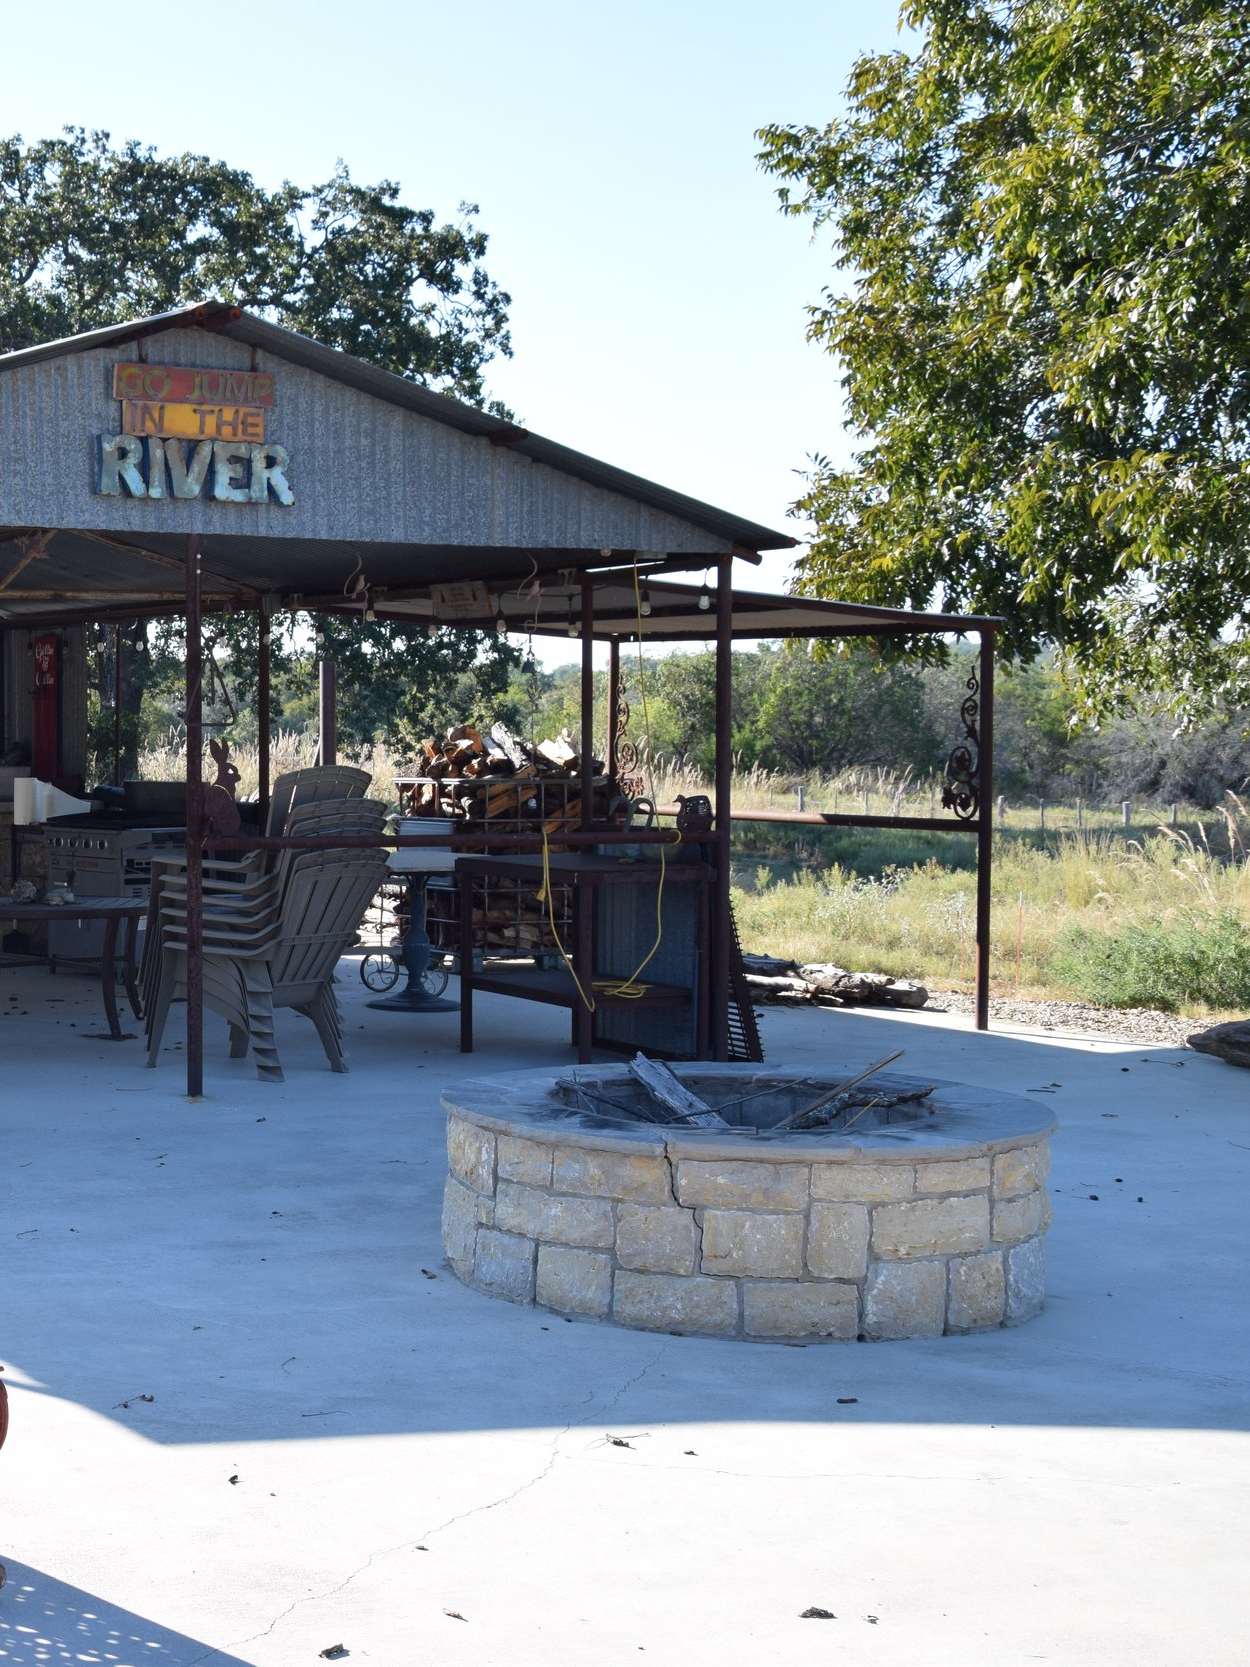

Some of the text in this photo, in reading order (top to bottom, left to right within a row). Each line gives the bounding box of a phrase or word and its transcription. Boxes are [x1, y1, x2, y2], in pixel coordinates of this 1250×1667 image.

[119, 367, 273, 401] GO JUMP
[128, 401, 261, 438] IN THE
[97, 433, 296, 506] RIVER
